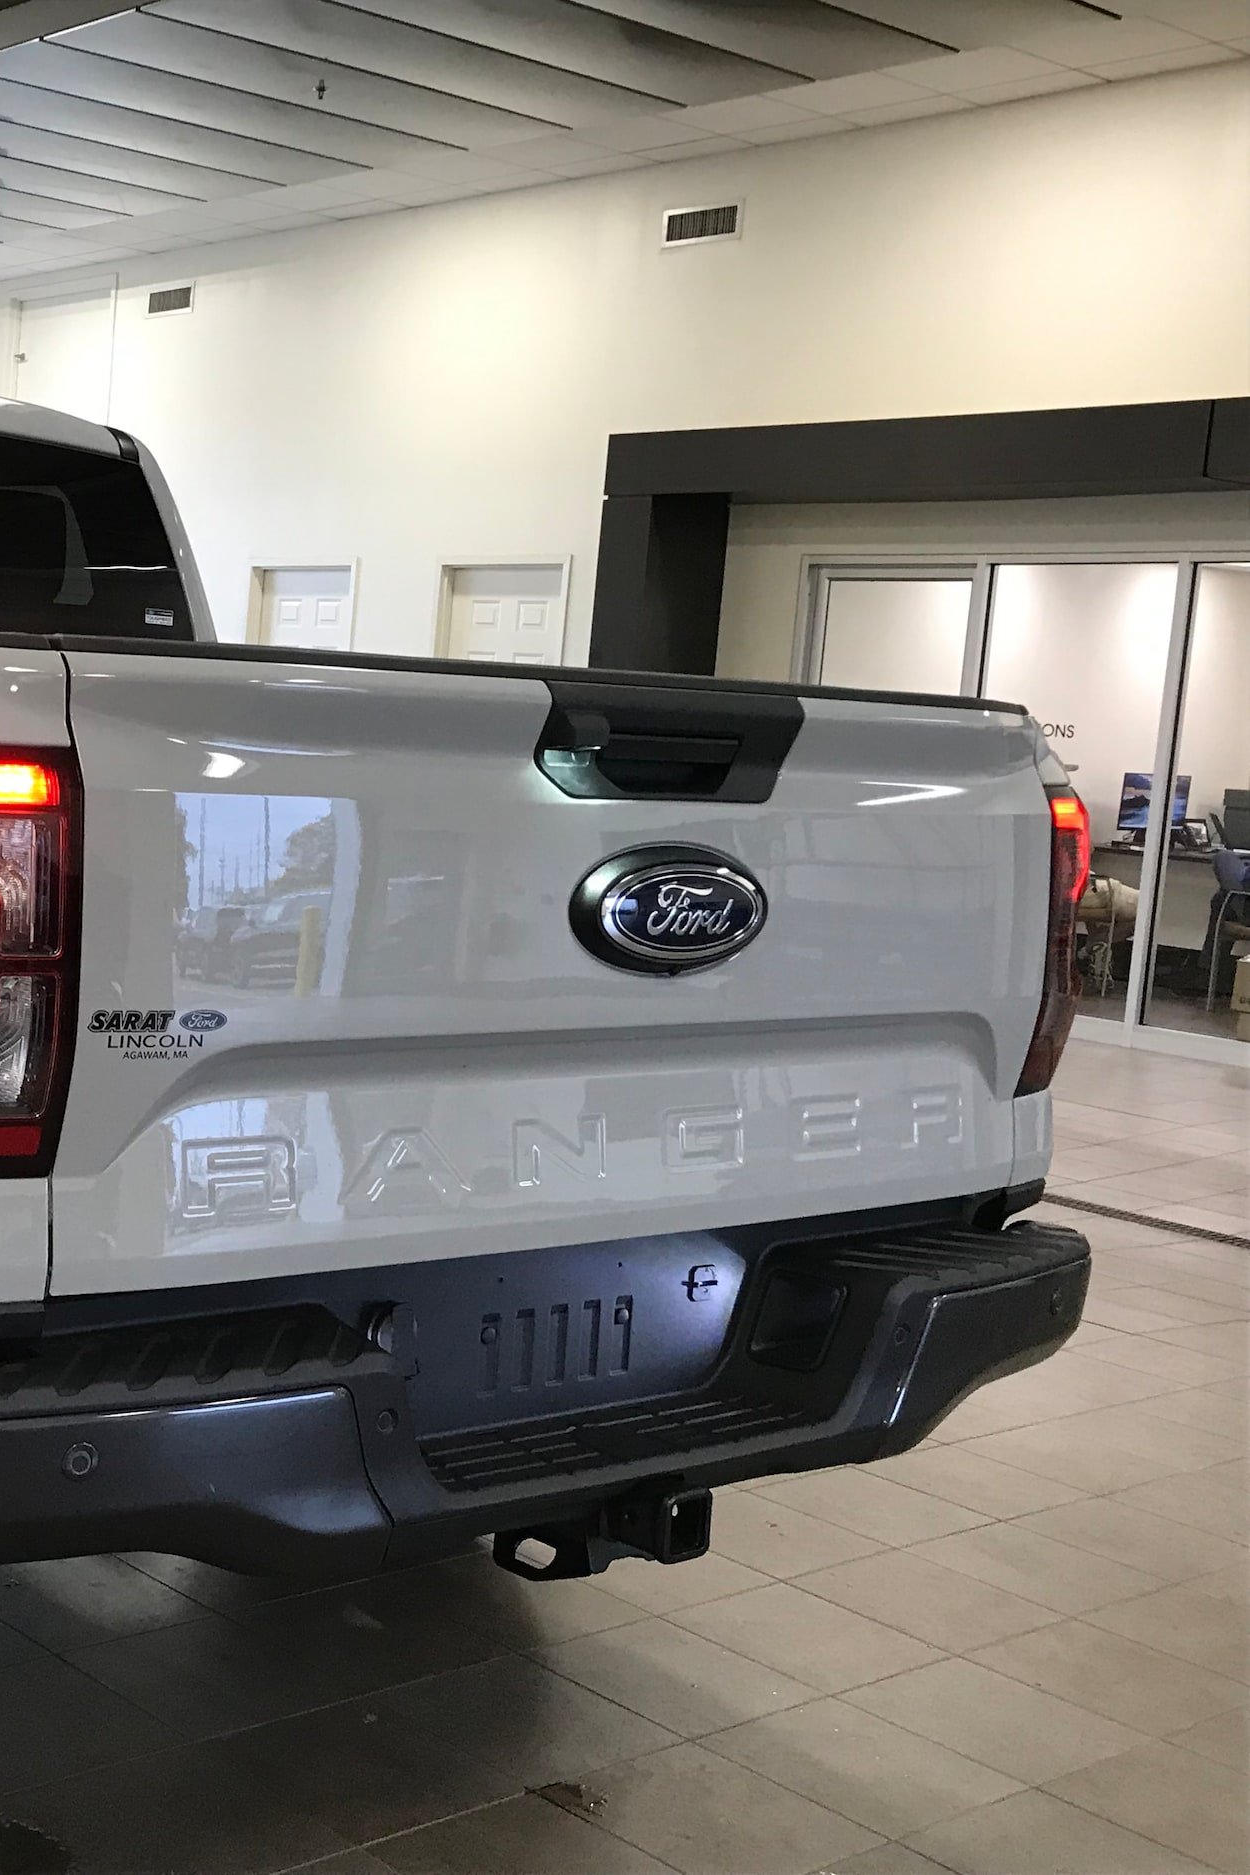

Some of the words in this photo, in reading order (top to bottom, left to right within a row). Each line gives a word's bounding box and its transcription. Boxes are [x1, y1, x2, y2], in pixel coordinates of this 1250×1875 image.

[1041, 723, 1075, 739] ONS
[646, 881, 734, 936] Ford
[87, 1010, 176, 1033] SARAT
[107, 1034, 204, 1049] LINCOLN
[122, 1050, 171, 1061] AGAWAM,
[172, 1050, 189, 1060] MA
[181, 1084, 963, 1218] RANGER
